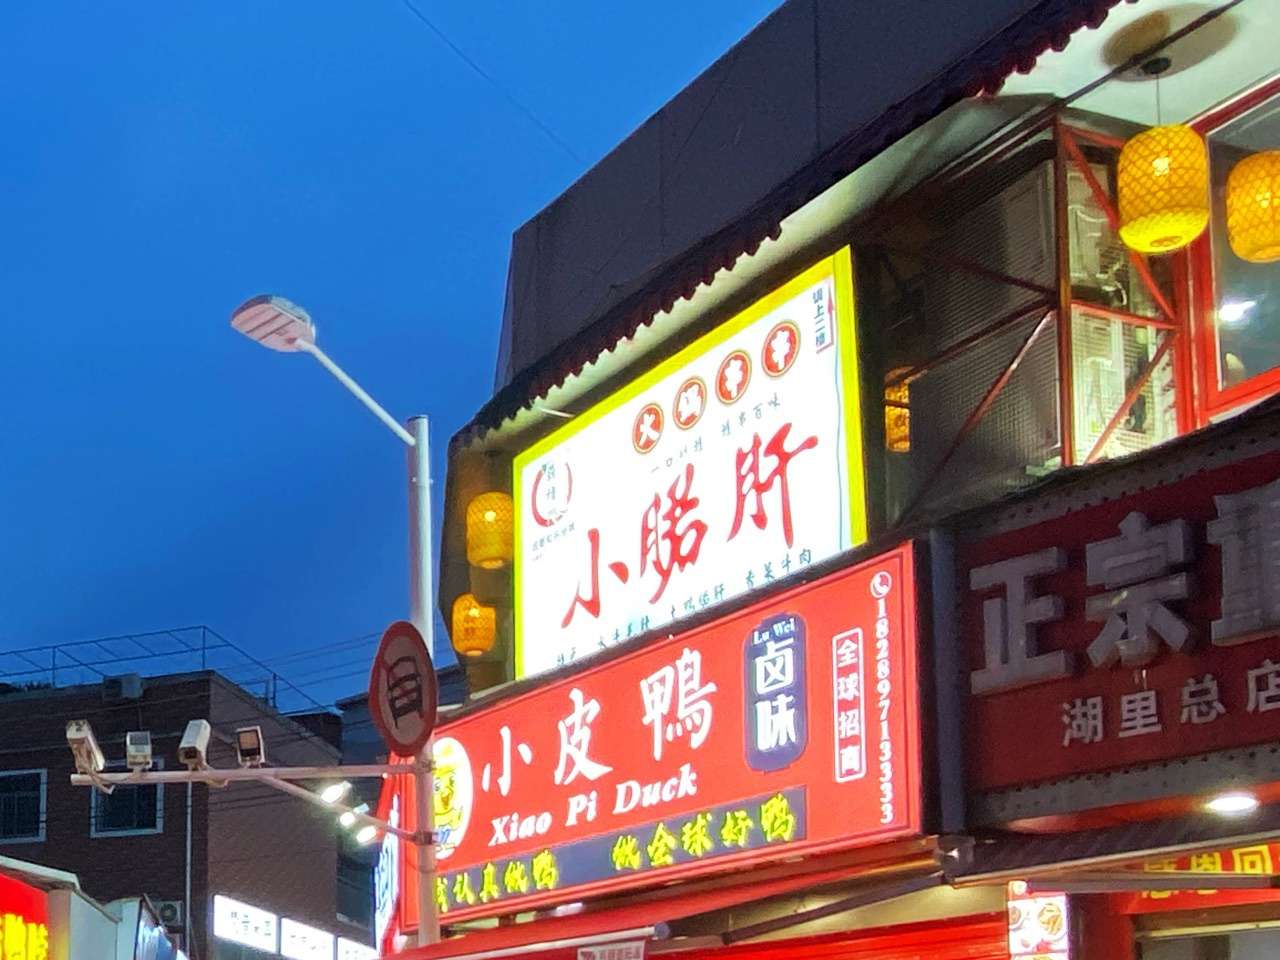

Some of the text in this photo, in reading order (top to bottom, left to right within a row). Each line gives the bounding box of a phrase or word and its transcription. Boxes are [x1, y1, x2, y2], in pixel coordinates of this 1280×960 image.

[754, 638, 797, 752] 卤味
[836, 637, 862, 777] 全球招商
[875, 598, 895, 825] 18289713333
[1062, 658, 1280, 747] 湖里总店
[488, 763, 698, 848] Xiao Pi Duck
